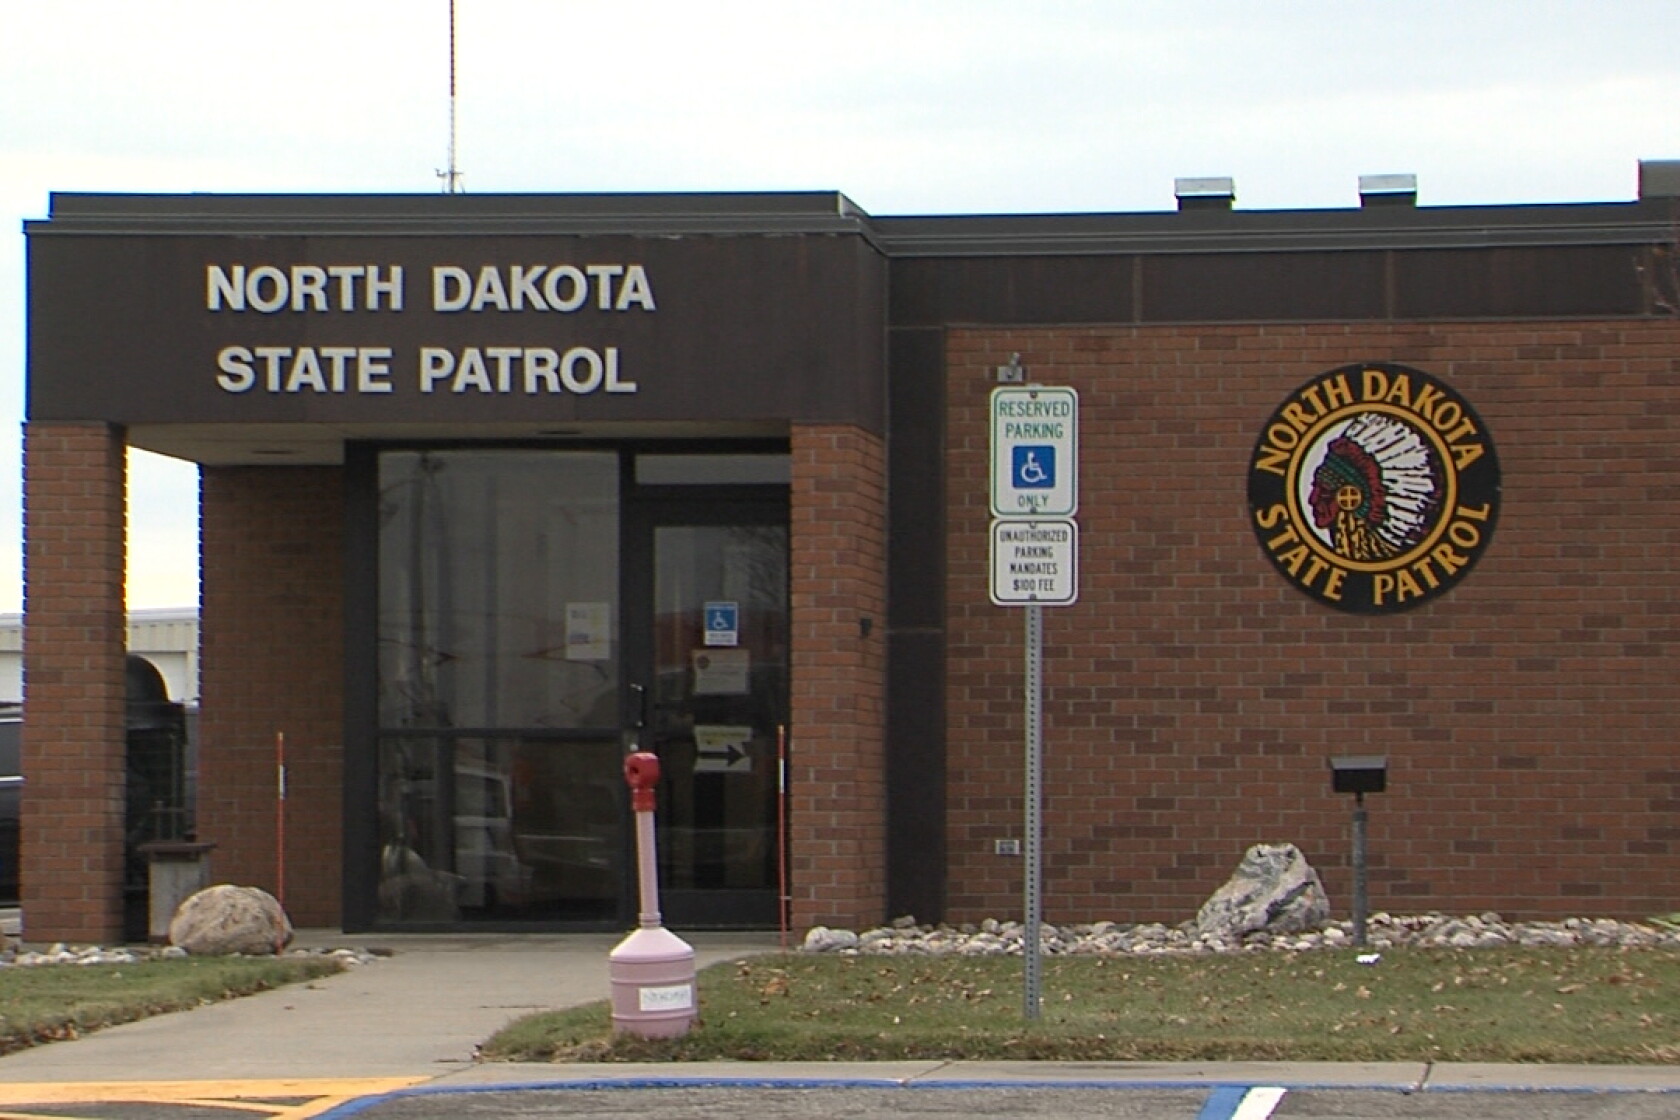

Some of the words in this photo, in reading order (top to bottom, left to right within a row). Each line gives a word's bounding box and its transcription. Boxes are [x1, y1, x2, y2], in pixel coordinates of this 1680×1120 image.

[207, 265, 403, 312] NORTH
[432, 265, 656, 312] DAKOTA
[217, 346, 392, 392] STATE
[420, 347, 636, 393] PATROL
[999, 400, 1070, 417] RESERVED
[1005, 423, 1063, 439] PARKING
[1256, 374, 1354, 476] NORTH
[1362, 370, 1485, 470] DAKOTA
[1018, 495, 1049, 507] ONLY
[1000, 530, 1068, 542] UNAUTHORIZED
[1014, 546, 1054, 558] PARKING
[1256, 503, 1347, 601] STATE
[1373, 503, 1490, 605] PATROL
[1010, 562, 1057, 574] MANDATES
[1013, 579, 1036, 591] $100
[1038, 579, 1055, 591] FEE
